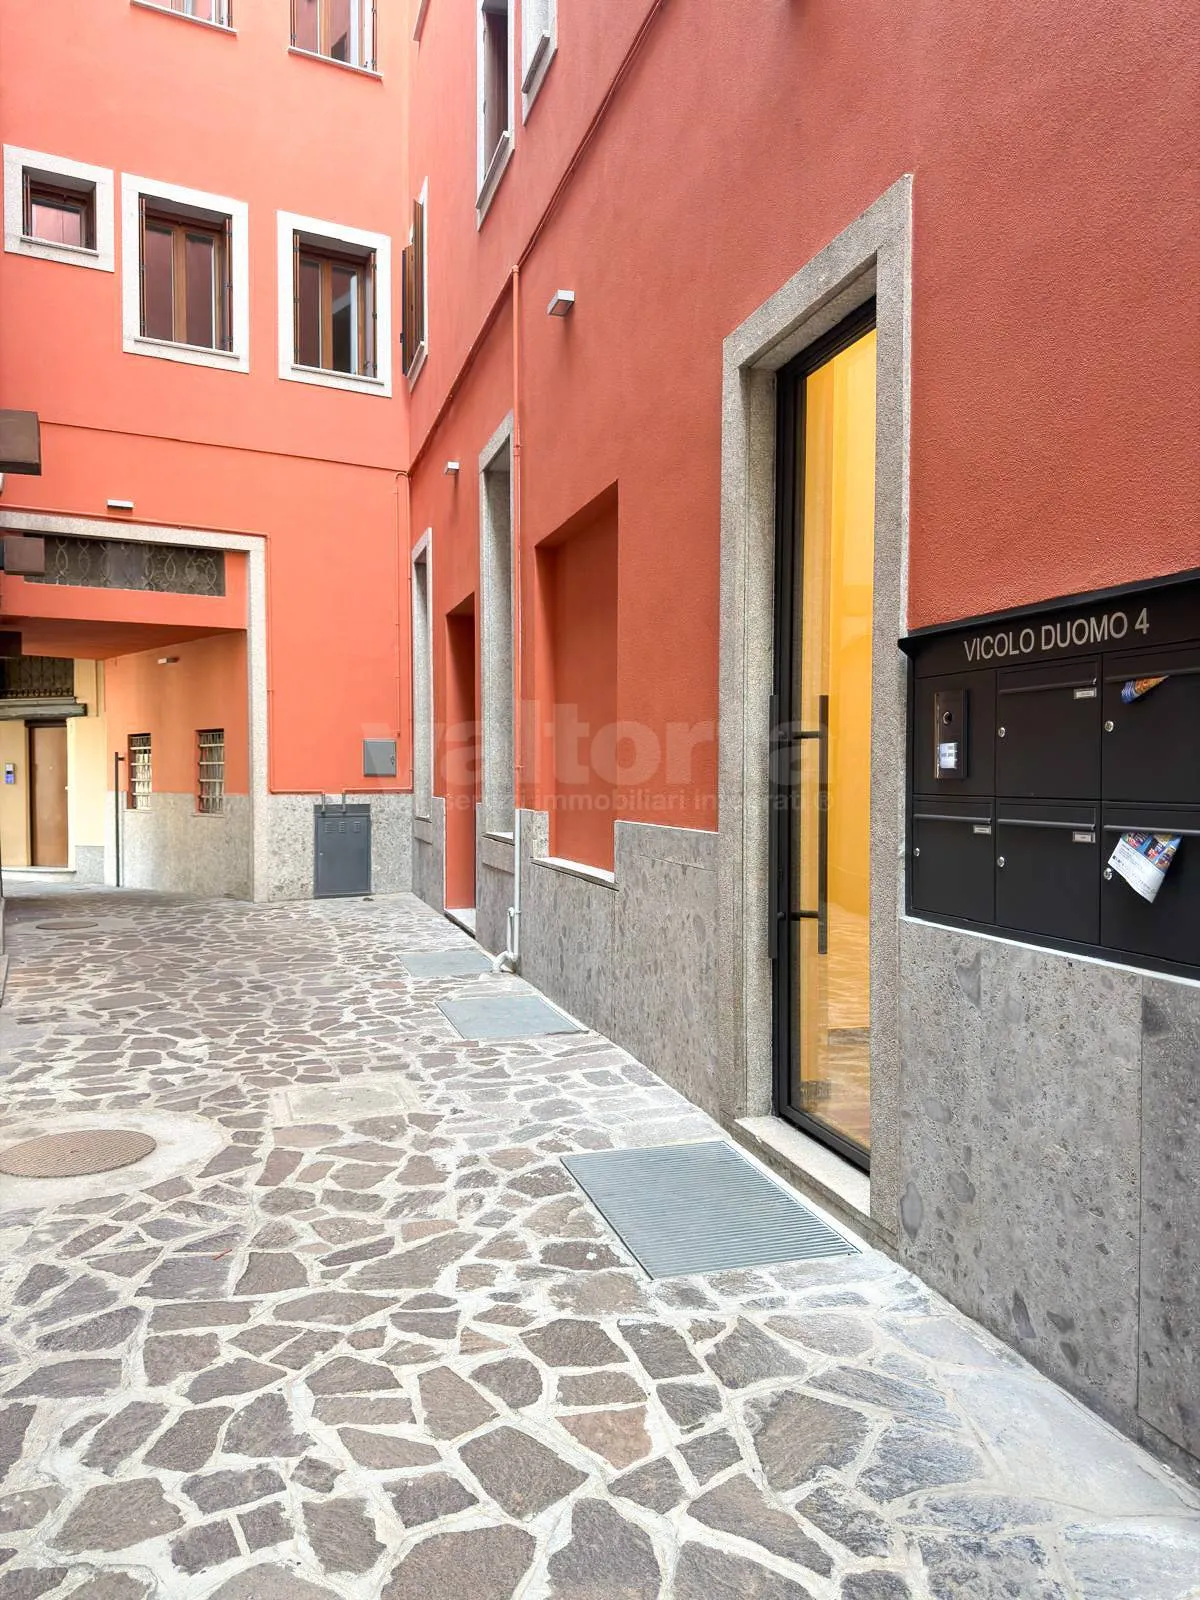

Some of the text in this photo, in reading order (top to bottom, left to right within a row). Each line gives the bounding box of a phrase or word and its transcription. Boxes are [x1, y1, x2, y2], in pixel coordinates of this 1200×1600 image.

[963, 607, 1150, 662] VICOLO DUOMO 4
